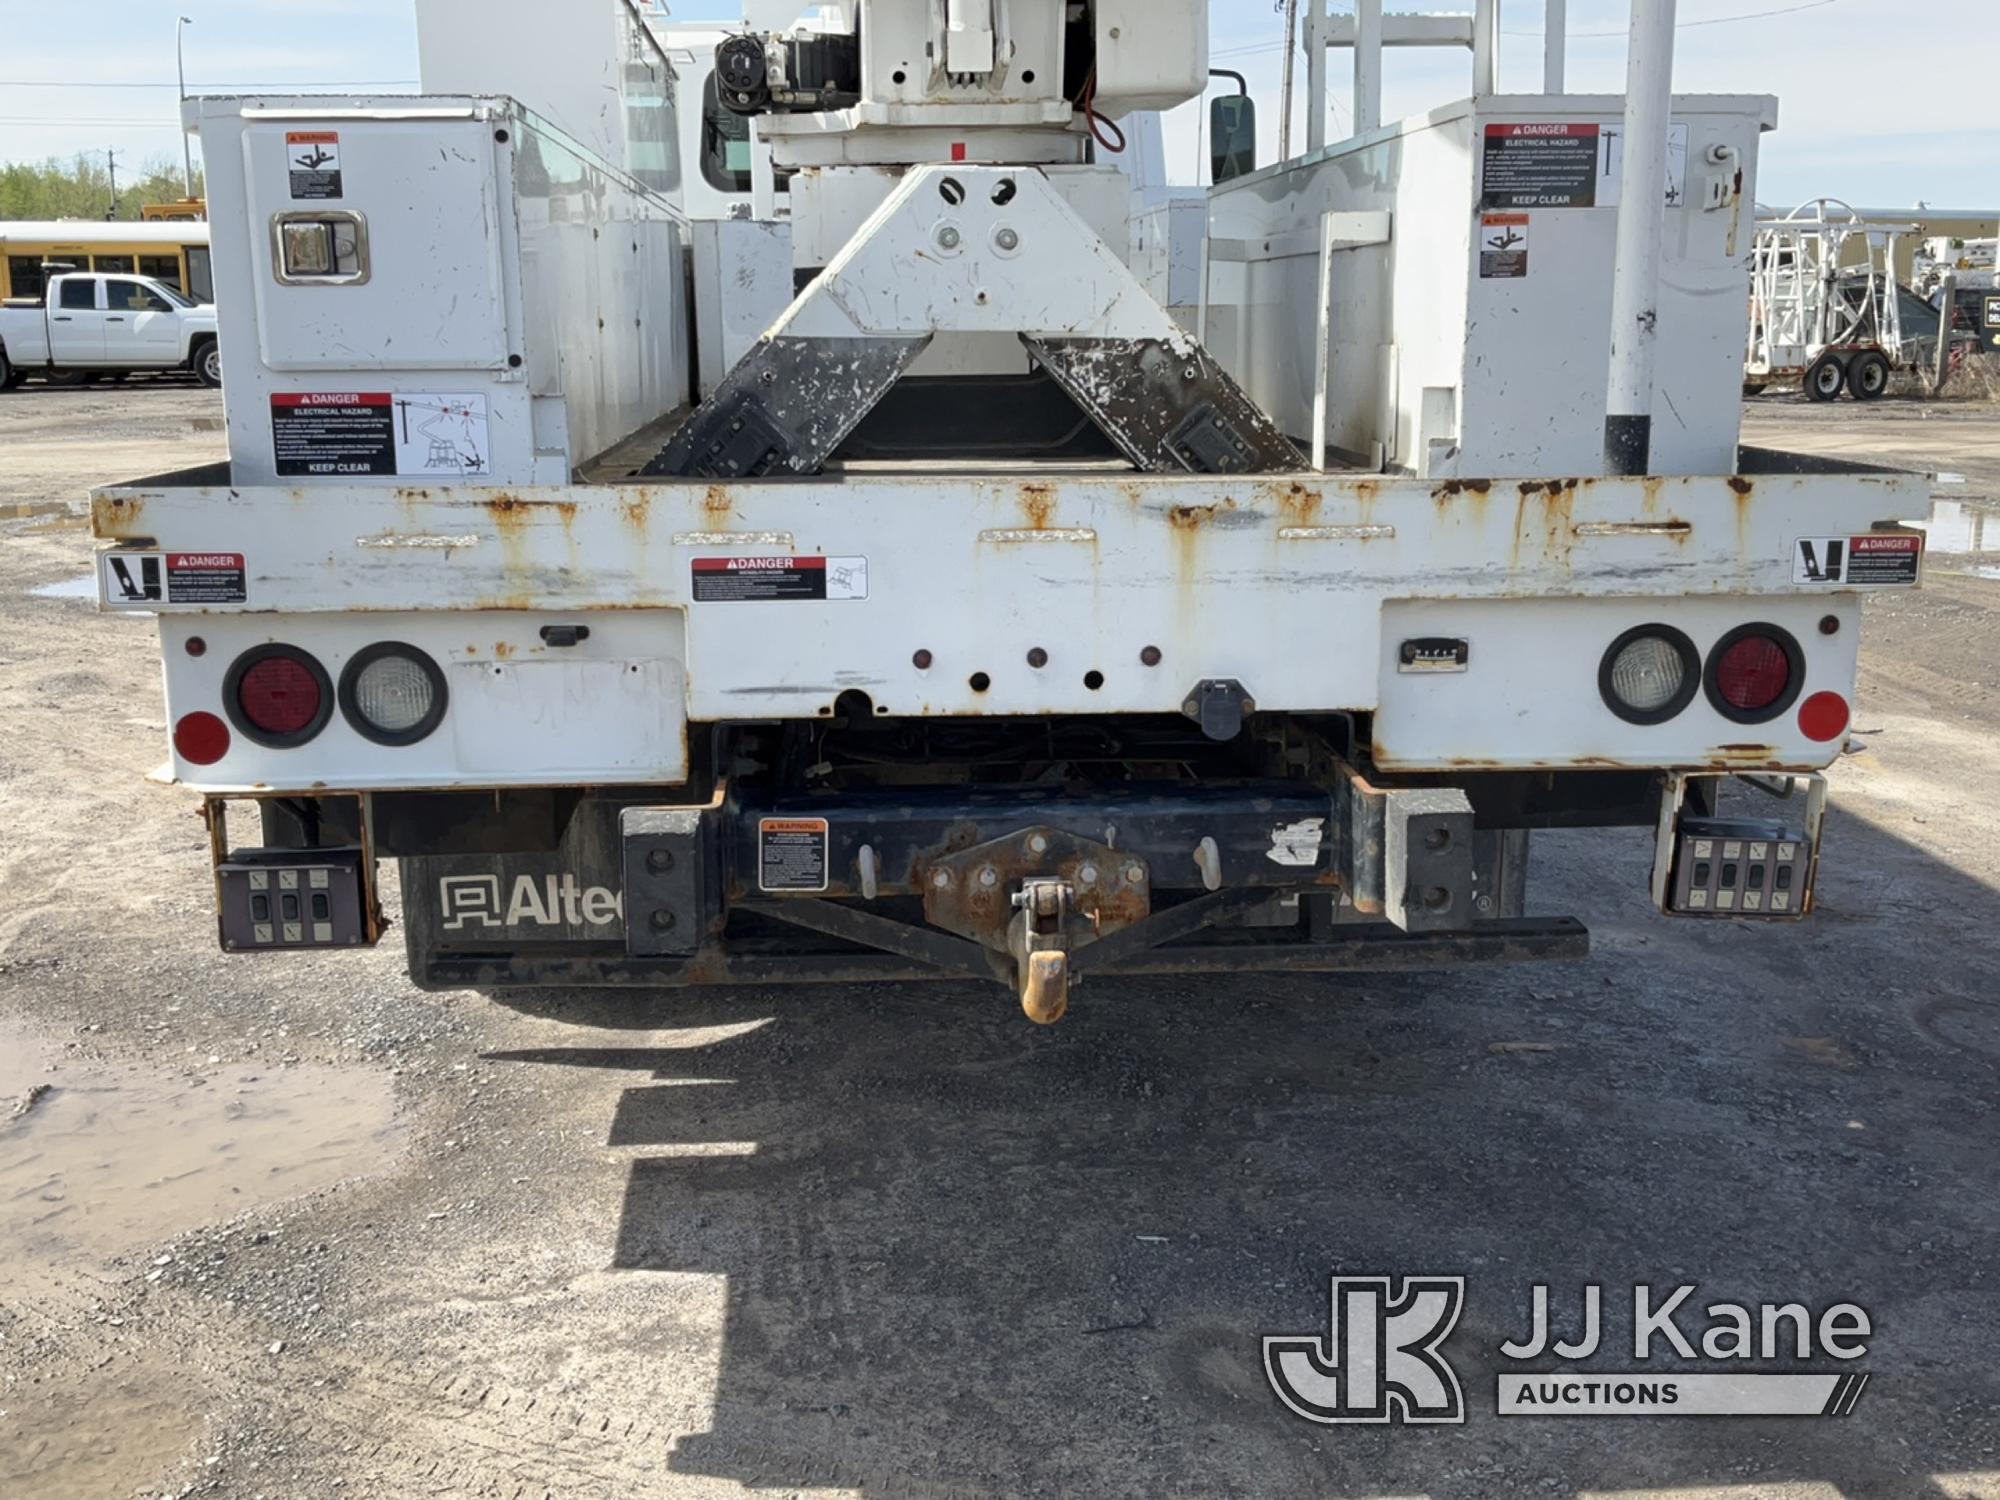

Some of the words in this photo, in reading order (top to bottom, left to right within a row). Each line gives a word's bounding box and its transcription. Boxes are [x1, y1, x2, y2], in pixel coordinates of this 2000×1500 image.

[1523, 125, 1569, 134] DANGER
[1505, 139, 1548, 147] ELECTRICAL
[1512, 195, 1537, 204] KEEP
[1538, 195, 1570, 204] CLEAR
[311, 394, 360, 404] DANGER
[294, 408, 340, 416] ELECTRICAL
[309, 463, 336, 472] KEEP
[337, 463, 371, 472] CLEAR
[1870, 539, 1911, 549] DANGER
[189, 556, 235, 566] DANGER
[738, 558, 794, 569] DANGER
